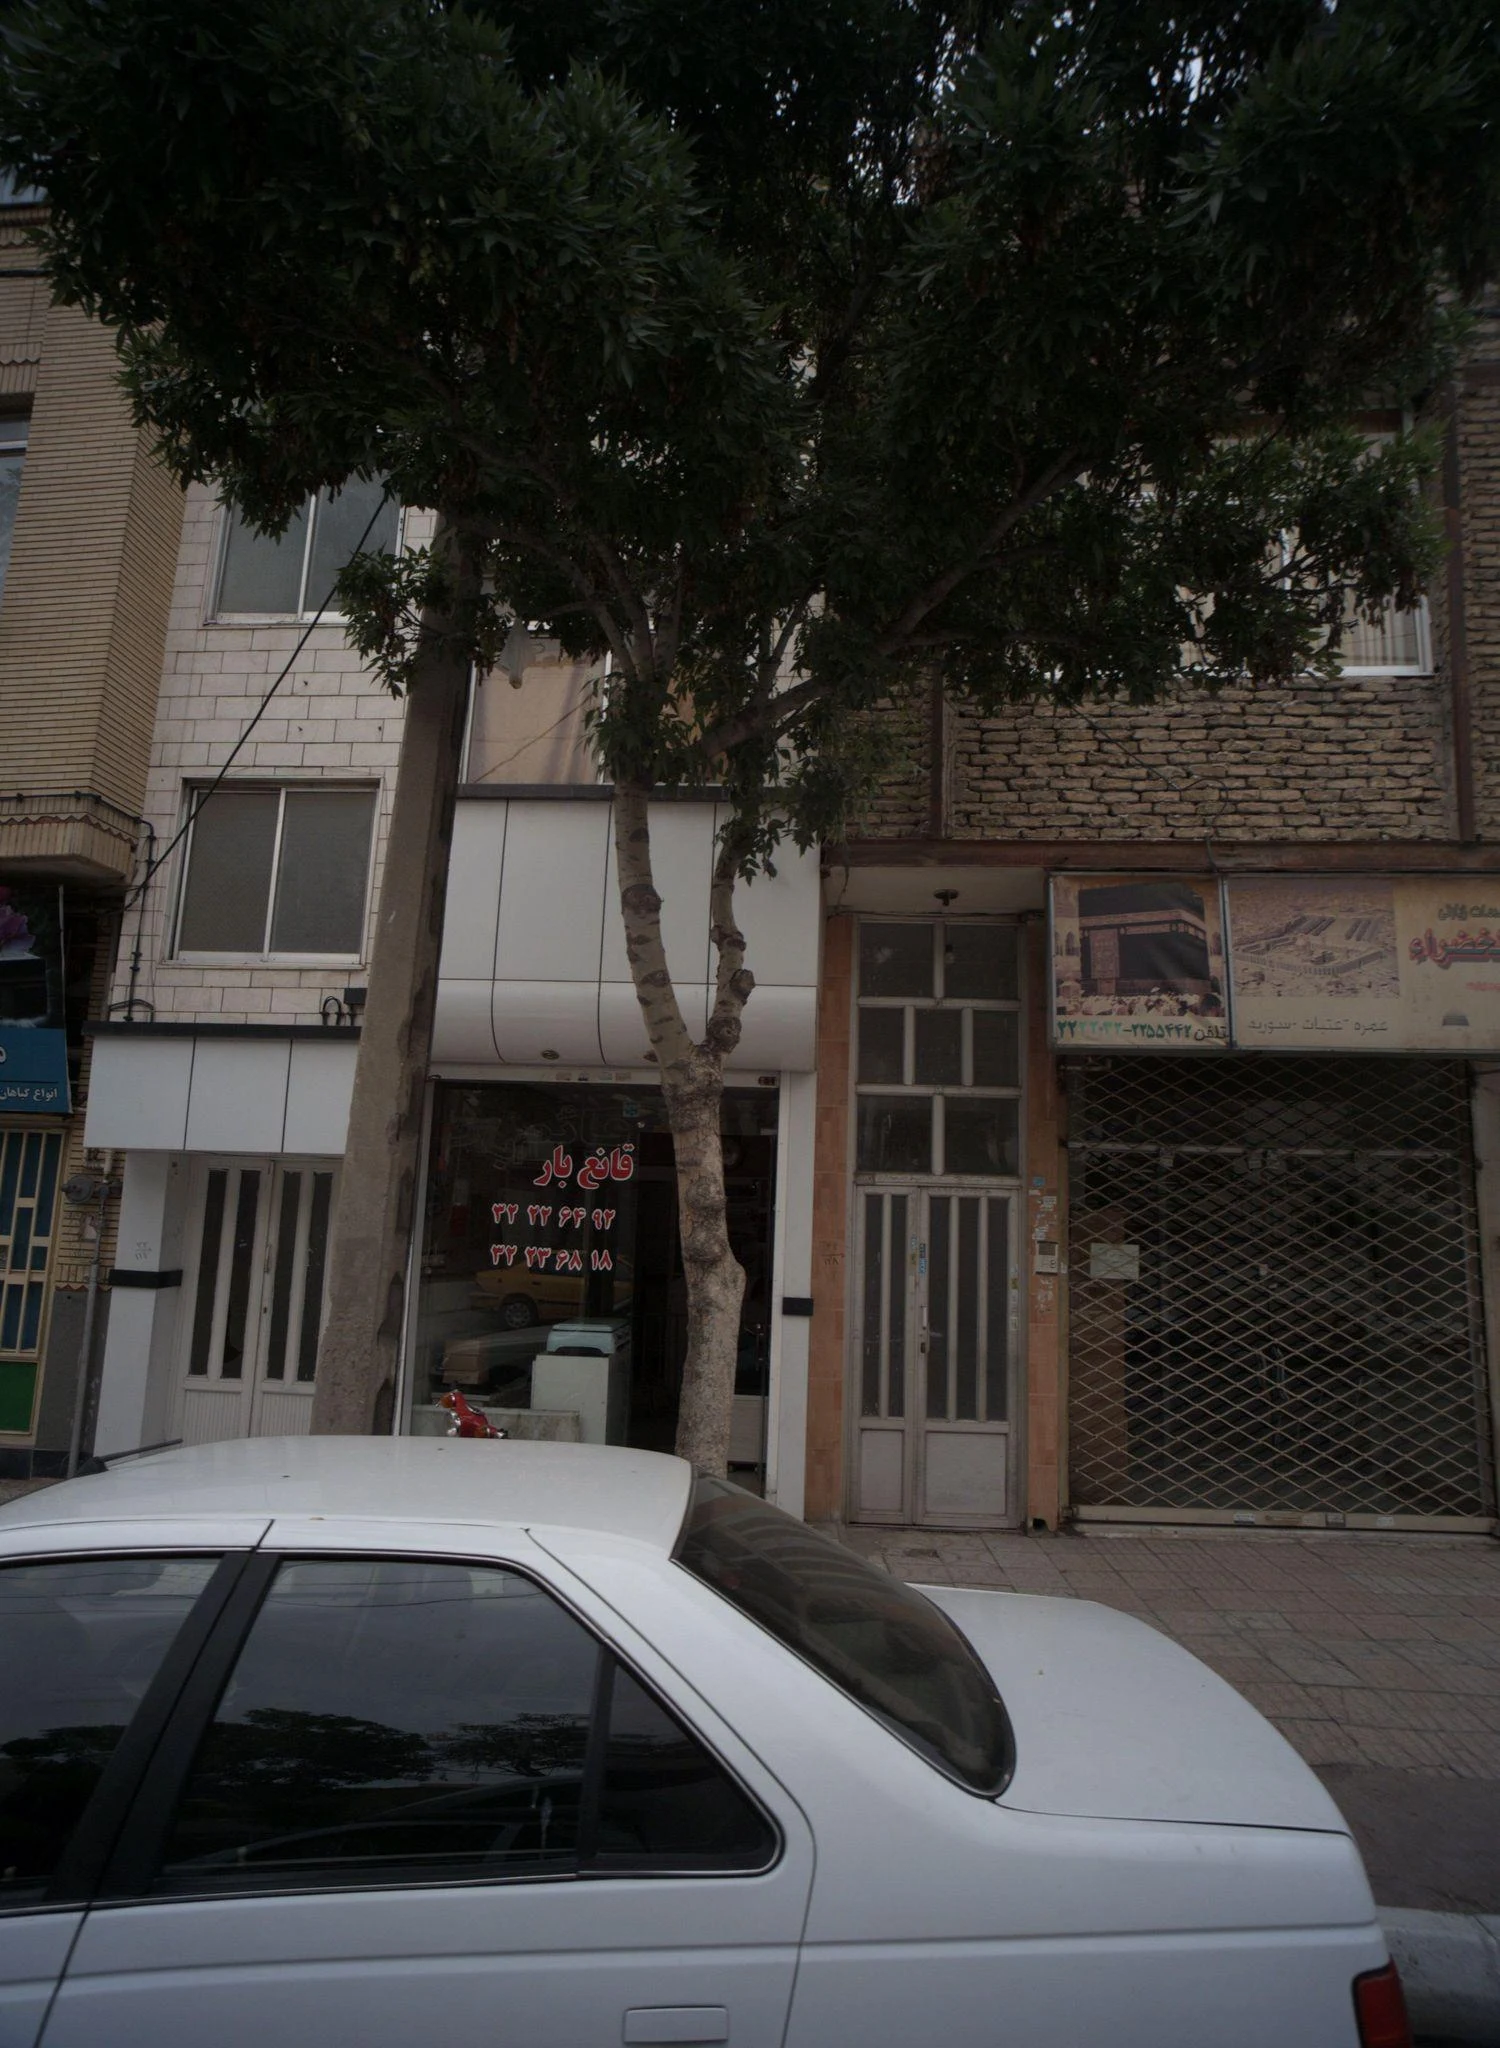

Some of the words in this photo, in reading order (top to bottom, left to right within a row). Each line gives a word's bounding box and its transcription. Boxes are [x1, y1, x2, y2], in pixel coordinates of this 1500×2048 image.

[1408, 926, 1500, 968] خضراء
[1194, 1024, 1229, 1041] تلفن
[33, 1087, 58, 1102] انواع
[533, 1143, 573, 1188] بار
[577, 1142, 635, 1190] قانع
[492, 1203, 519, 1225] ۳۲
[527, 1204, 553, 1227] ۲۲
[558, 1206, 587, 1229] ۶۴
[592, 1208, 617, 1230] ۹۲
[490, 1244, 518, 1267] ۳۲
[525, 1246, 552, 1269] ۲۳
[555, 1249, 583, 1271] ۶۸
[591, 1249, 613, 1271] ۱۸
